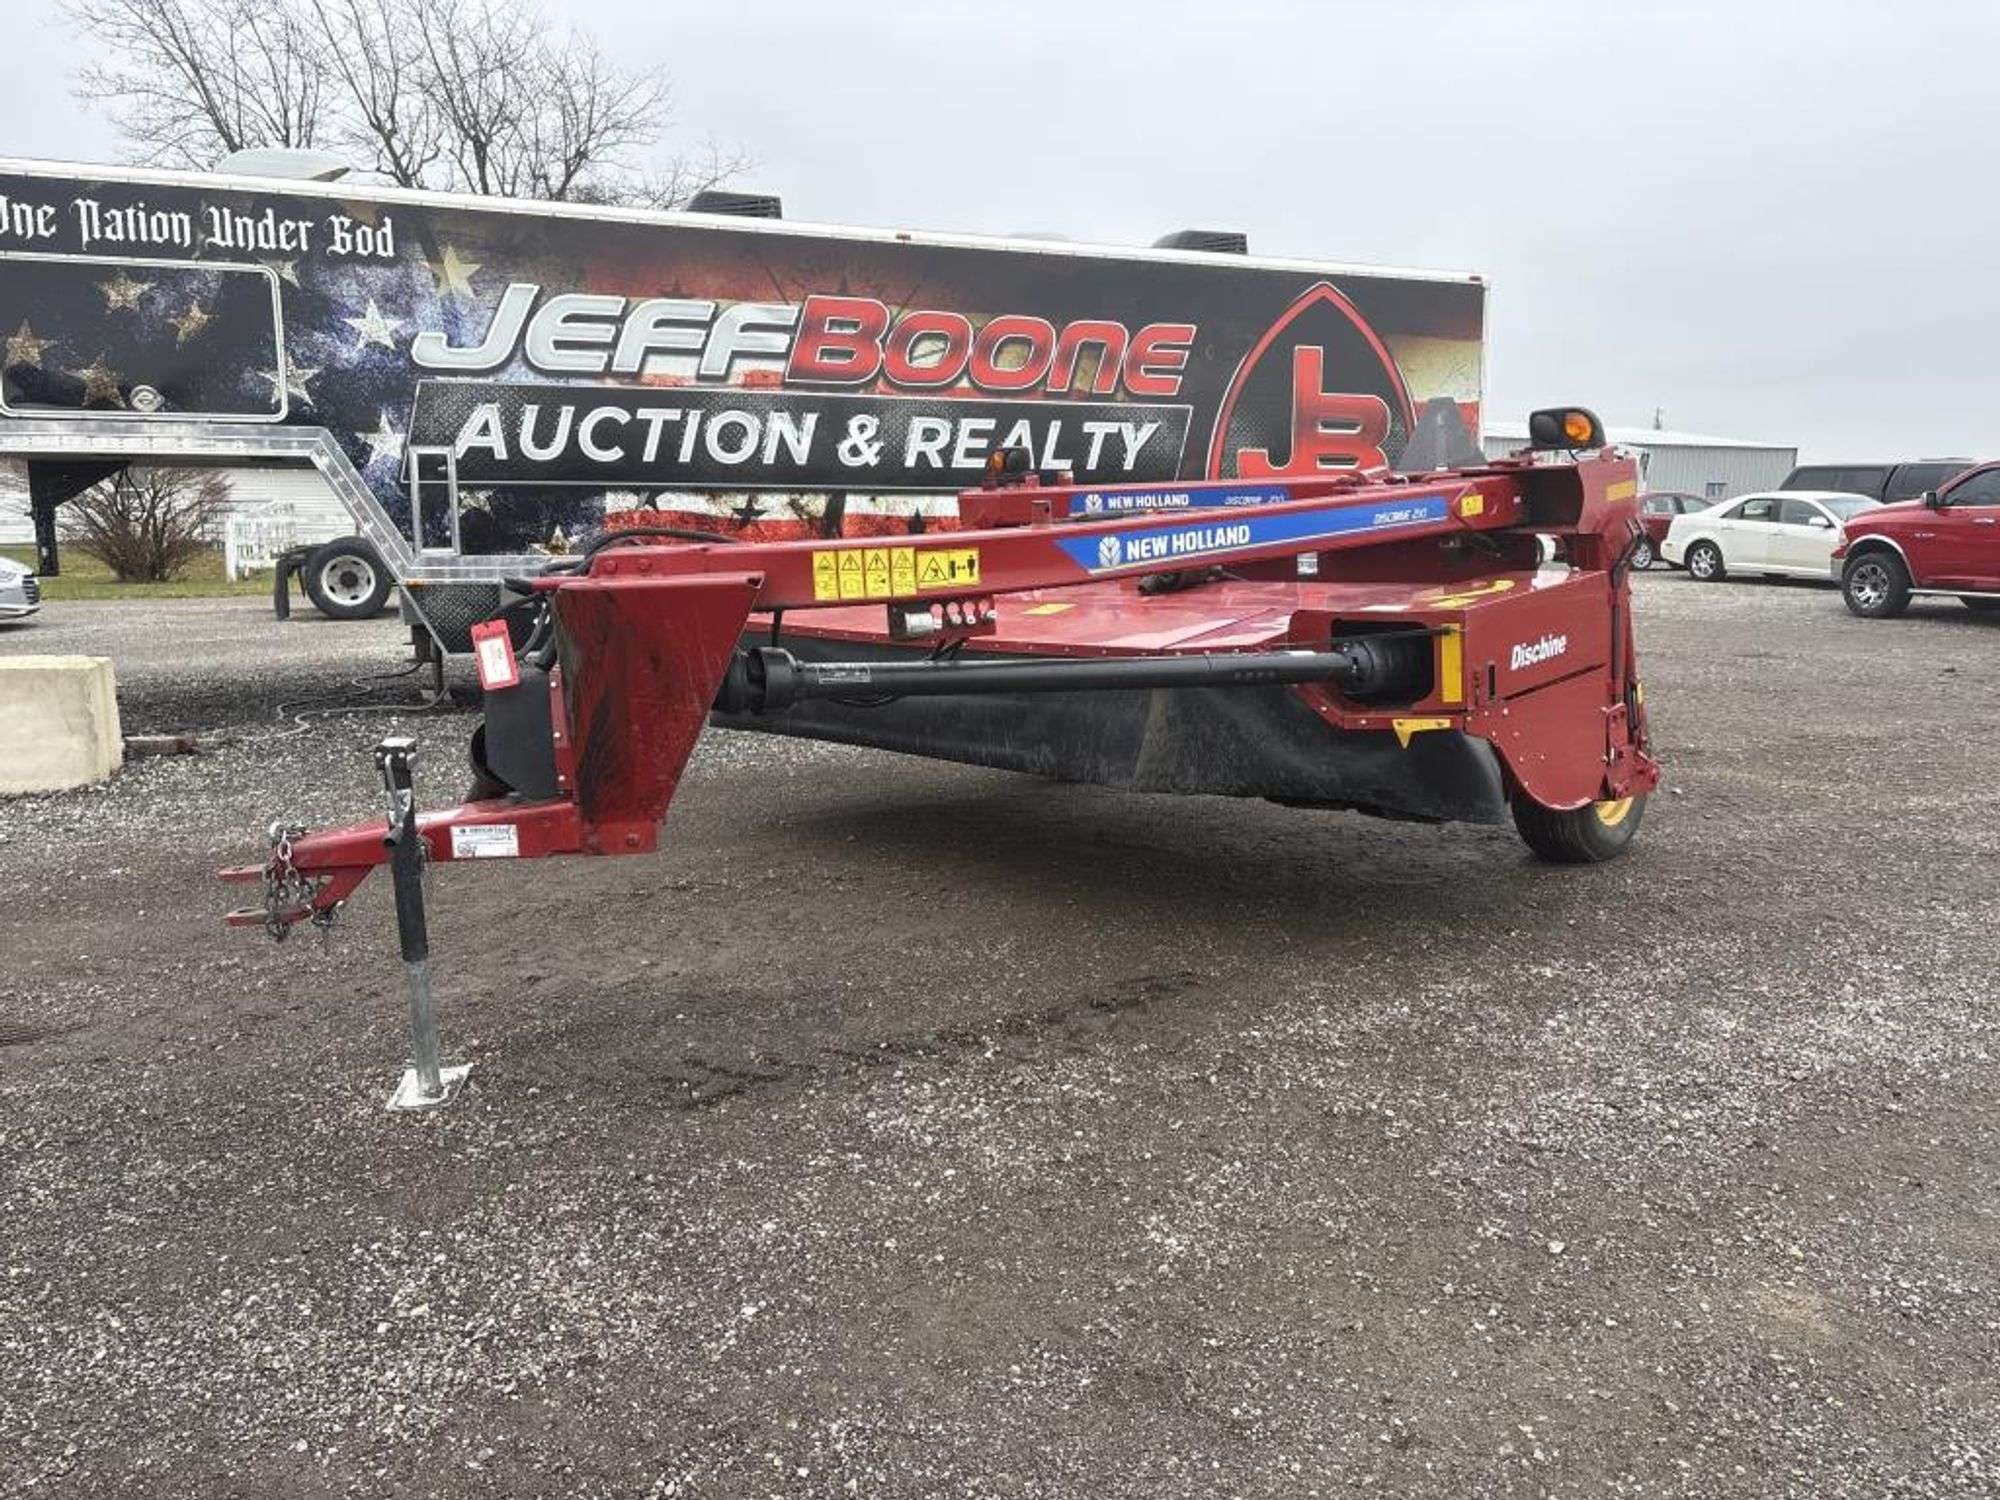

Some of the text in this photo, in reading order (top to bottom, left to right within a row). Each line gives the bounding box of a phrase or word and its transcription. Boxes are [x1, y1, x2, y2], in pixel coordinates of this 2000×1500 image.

[69, 198, 192, 251] Nation
[205, 206, 314, 251] Under
[326, 214, 395, 257] God
[455, 401, 1160, 471] AUCTION & REALTY
[1108, 497, 1135, 509] NEW
[1135, 494, 1189, 508] HOLLAND
[1126, 535, 1169, 560] NEW
[1172, 525, 1250, 553] HOLLAND
[1510, 633, 1567, 671] Discbine
